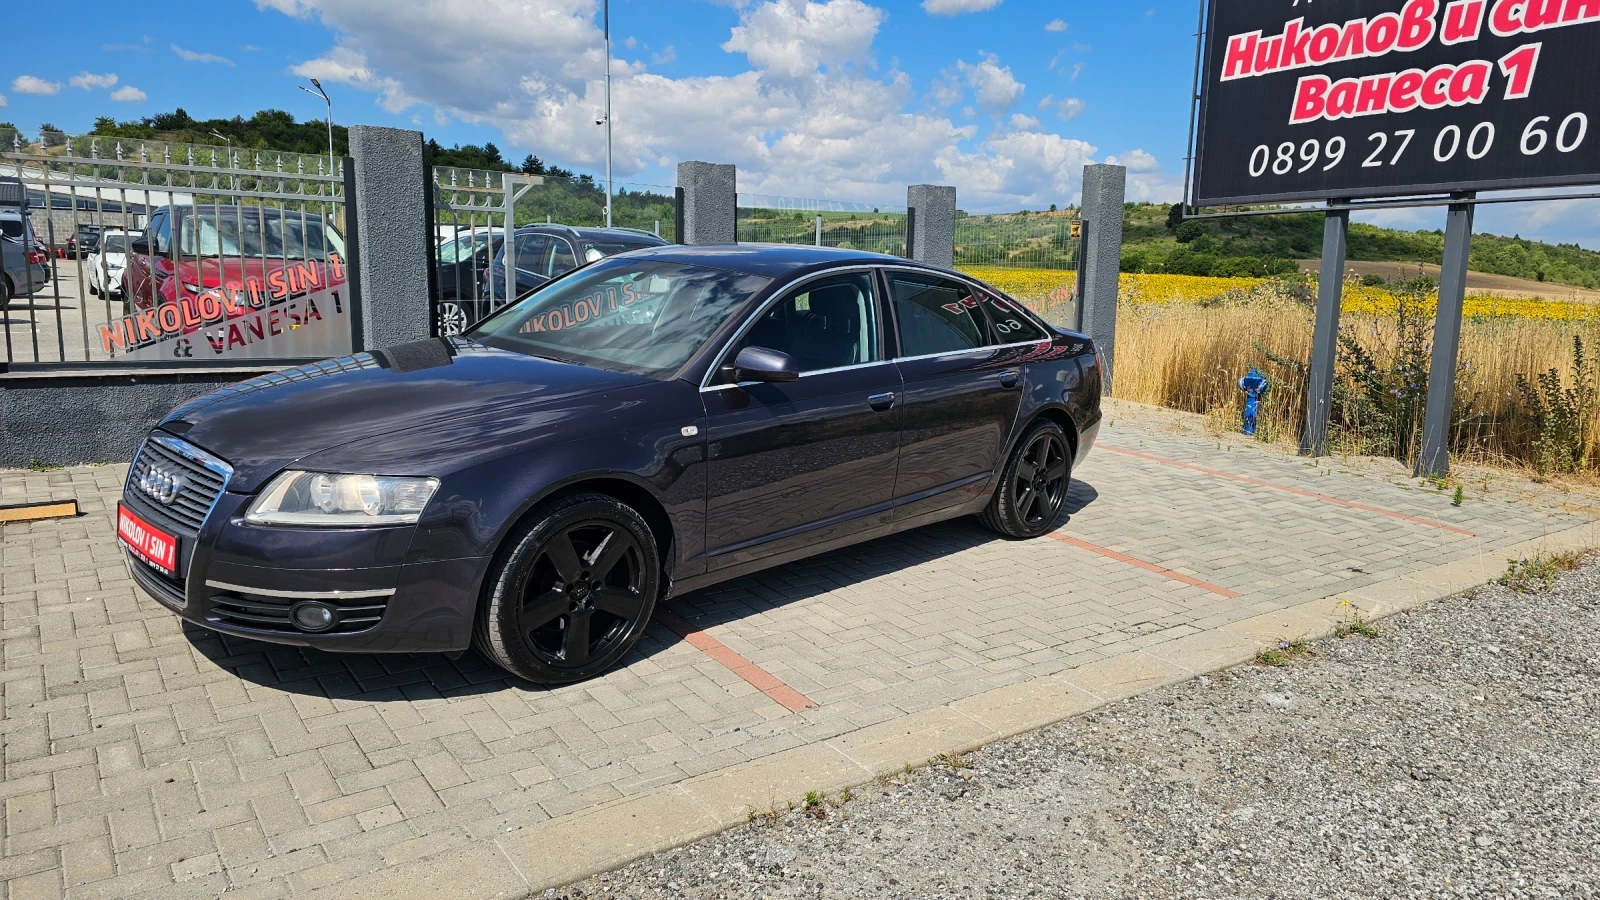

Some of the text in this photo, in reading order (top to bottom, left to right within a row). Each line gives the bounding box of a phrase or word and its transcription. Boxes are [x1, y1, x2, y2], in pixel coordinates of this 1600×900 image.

[1222, 0, 1438, 80] Николов
[1442, 0, 1486, 44] и
[1291, 43, 1541, 123] Ванеса 1
[1249, 112, 1588, 177] 0899 27 00 60
[98, 252, 343, 353] NIKOLOV I SIN 1
[173, 289, 343, 358] & VANESA 1
[518, 293, 602, 334] IKOLOV
[607, 289, 618, 311] I
[119, 512, 146, 548] NIKOLOV
[144, 532, 150, 552] I
[149, 535, 166, 561] SIN
